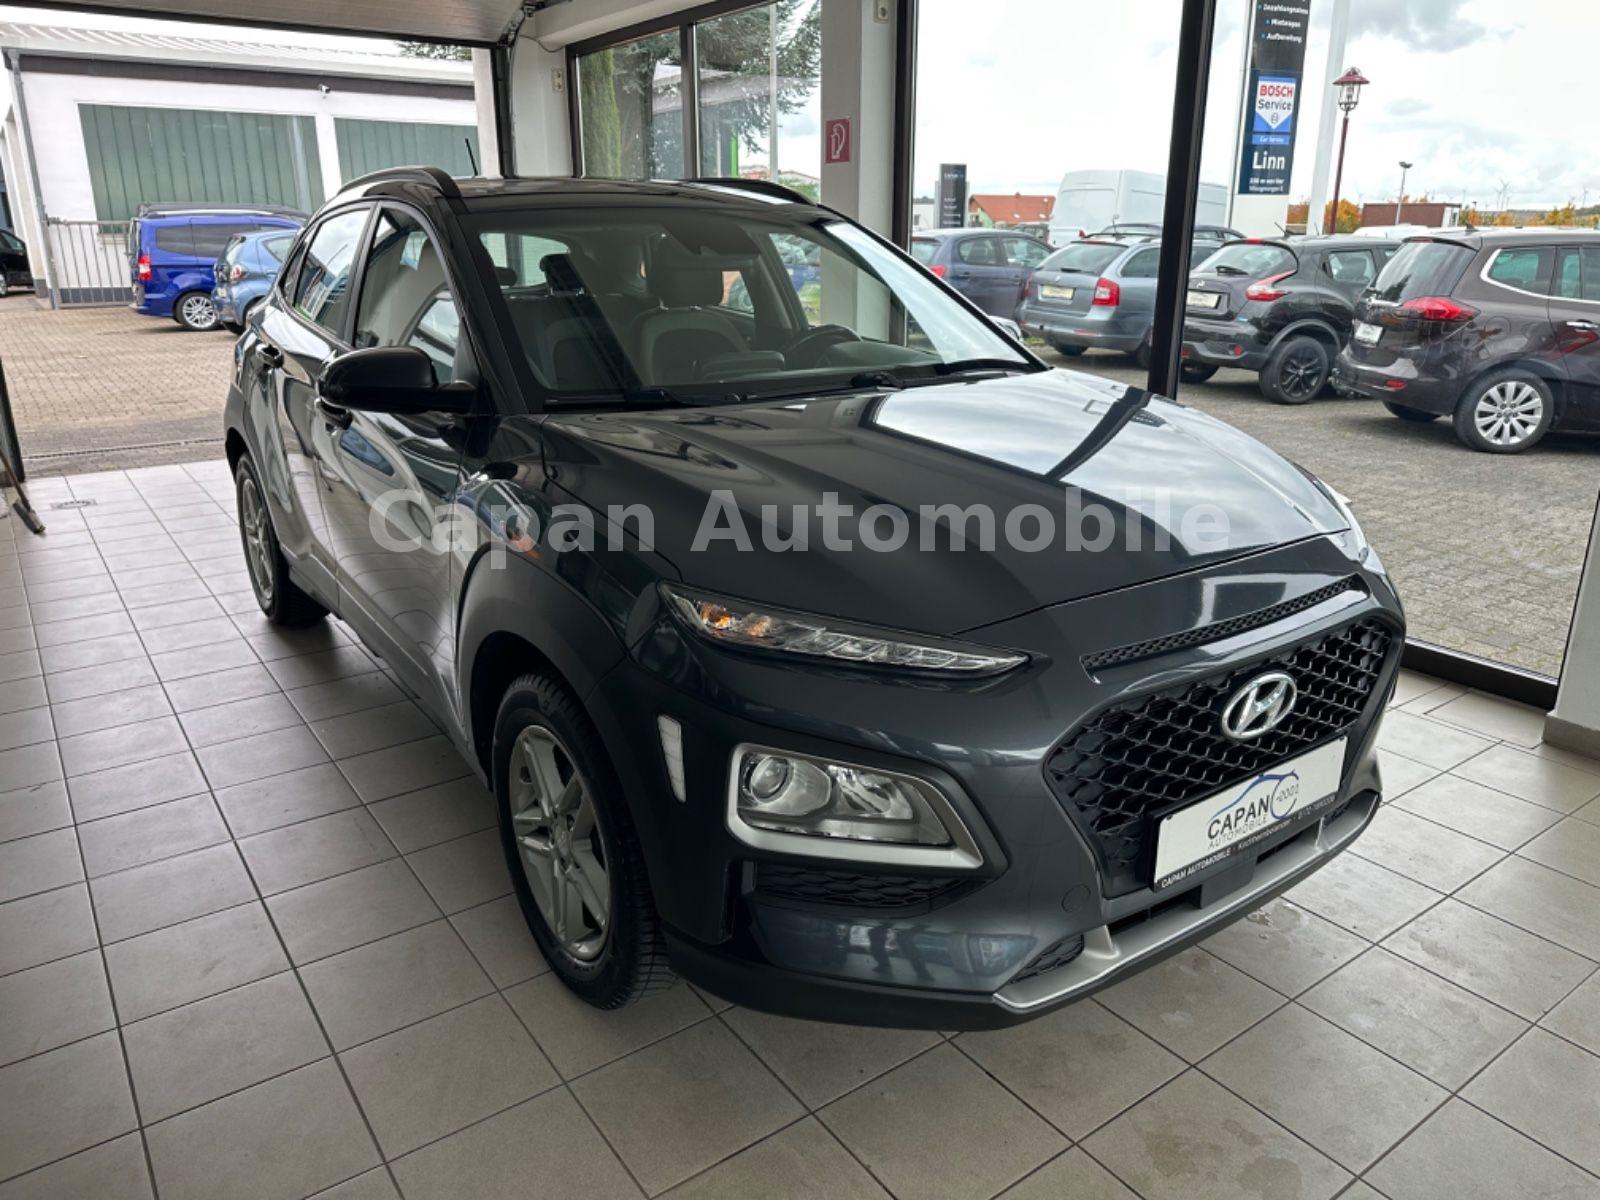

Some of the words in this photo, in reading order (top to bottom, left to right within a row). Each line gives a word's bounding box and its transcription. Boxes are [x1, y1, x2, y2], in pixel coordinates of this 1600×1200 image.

[1257, 98, 1291, 111] Service
[1260, 84, 1293, 98] BOSCH
[1252, 150, 1285, 170] Linn
[1207, 794, 1271, 840] CAPAN
[1207, 814, 1268, 850] AUTOMOBILE
[1161, 868, 1187, 888] CAPAN
[1186, 847, 1232, 876] AUTOMOBILE
